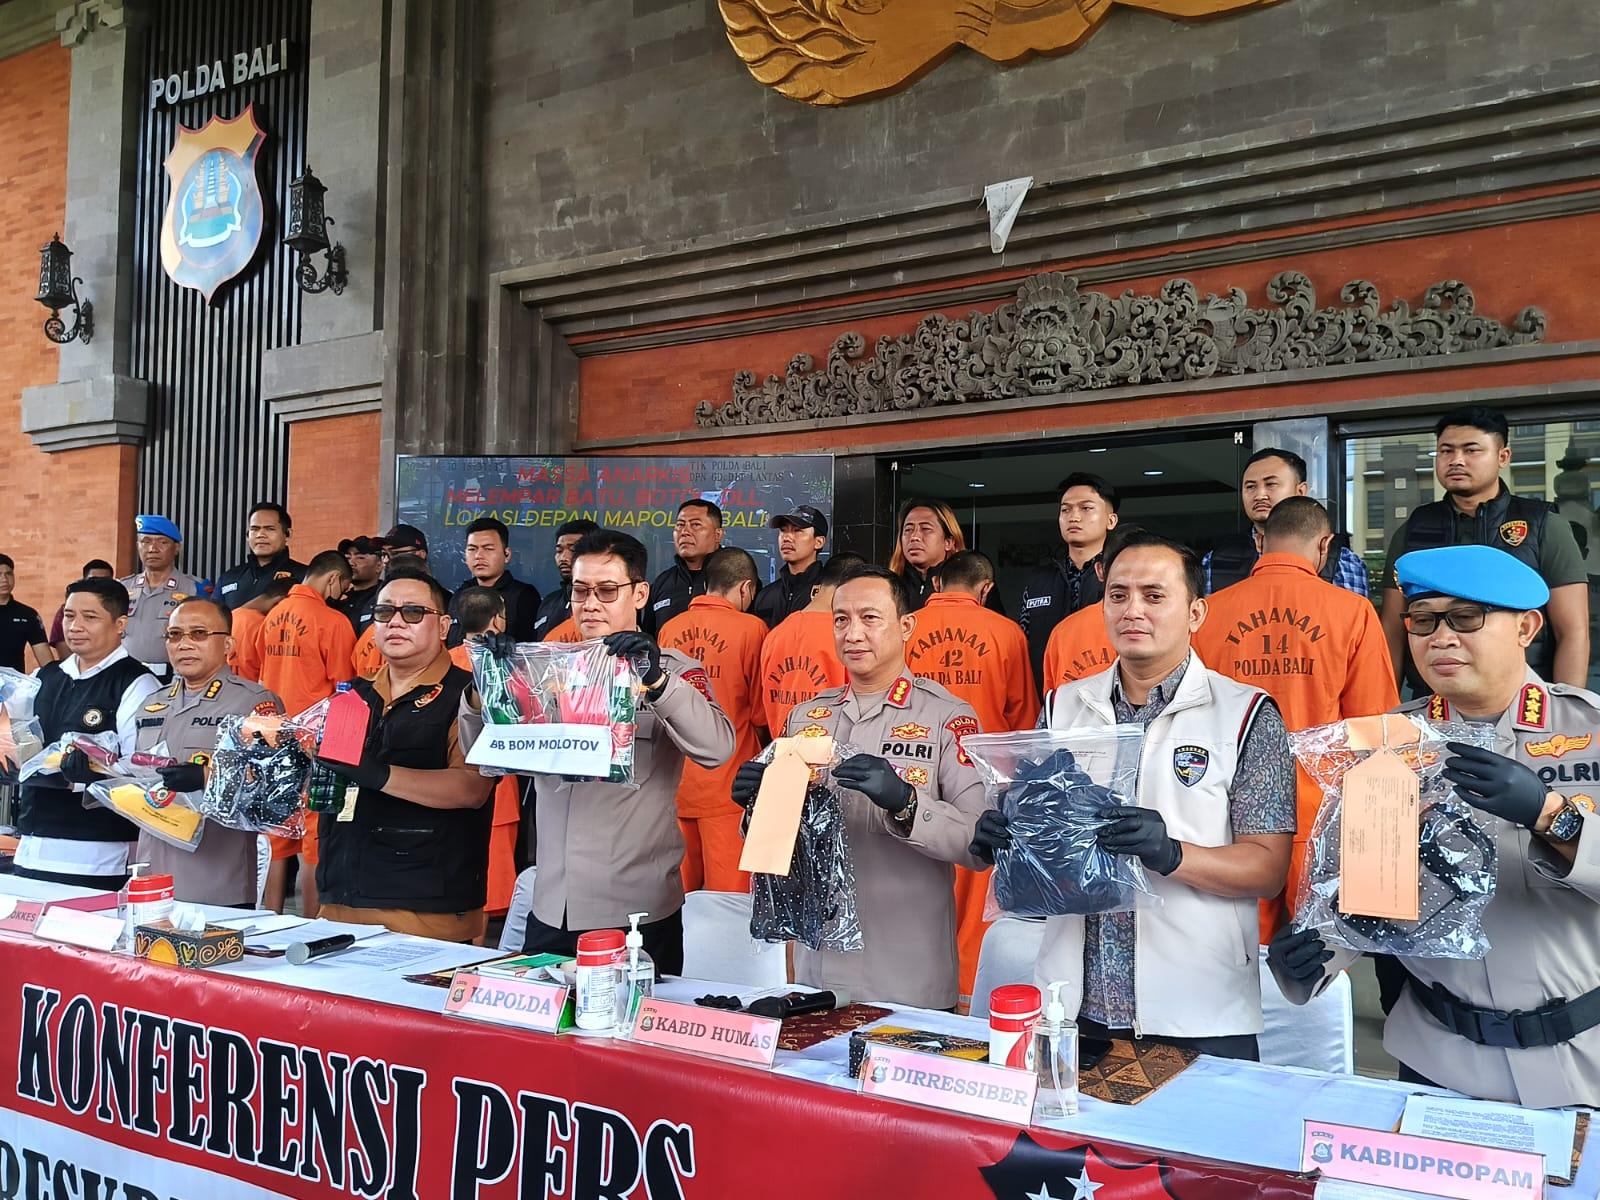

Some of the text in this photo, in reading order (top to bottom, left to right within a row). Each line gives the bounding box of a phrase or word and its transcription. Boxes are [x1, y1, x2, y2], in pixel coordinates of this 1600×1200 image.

[151, 38, 287, 110] POLDA BALI
[517, 466, 591, 484] MASSA
[712, 461, 740, 470] POLDA
[744, 461, 767, 470] BALI
[445, 509, 520, 527] LOKASI
[525, 509, 598, 527] DEPAN
[603, 509, 677, 527] MAPOL
[1224, 607, 1327, 645] TAHANAN
[672, 627, 729, 653] AHANAN
[910, 628, 990, 660] TAHANAN
[1262, 633, 1289, 655] 14
[939, 649, 964, 668] 42
[1234, 657, 1315, 677] POLDA BALI
[956, 670, 982, 685] BALI
[950, 718, 976, 729] POLDA
[489, 738, 600, 751] BB BOM MOLOTOV
[881, 743, 933, 760] POLRI
[1537, 761, 1600, 784] OLRI
[10, 910, 37, 922] OKKES
[468, 986, 551, 1015] KAPOLDA
[655, 1016, 772, 1050] KABID HUMAS
[16, 982, 697, 1200] KONFERENSI PERS
[891, 1066, 1029, 1107] DIRRESSIBER
[1340, 1142, 1534, 1190] KABIDPROPAM
